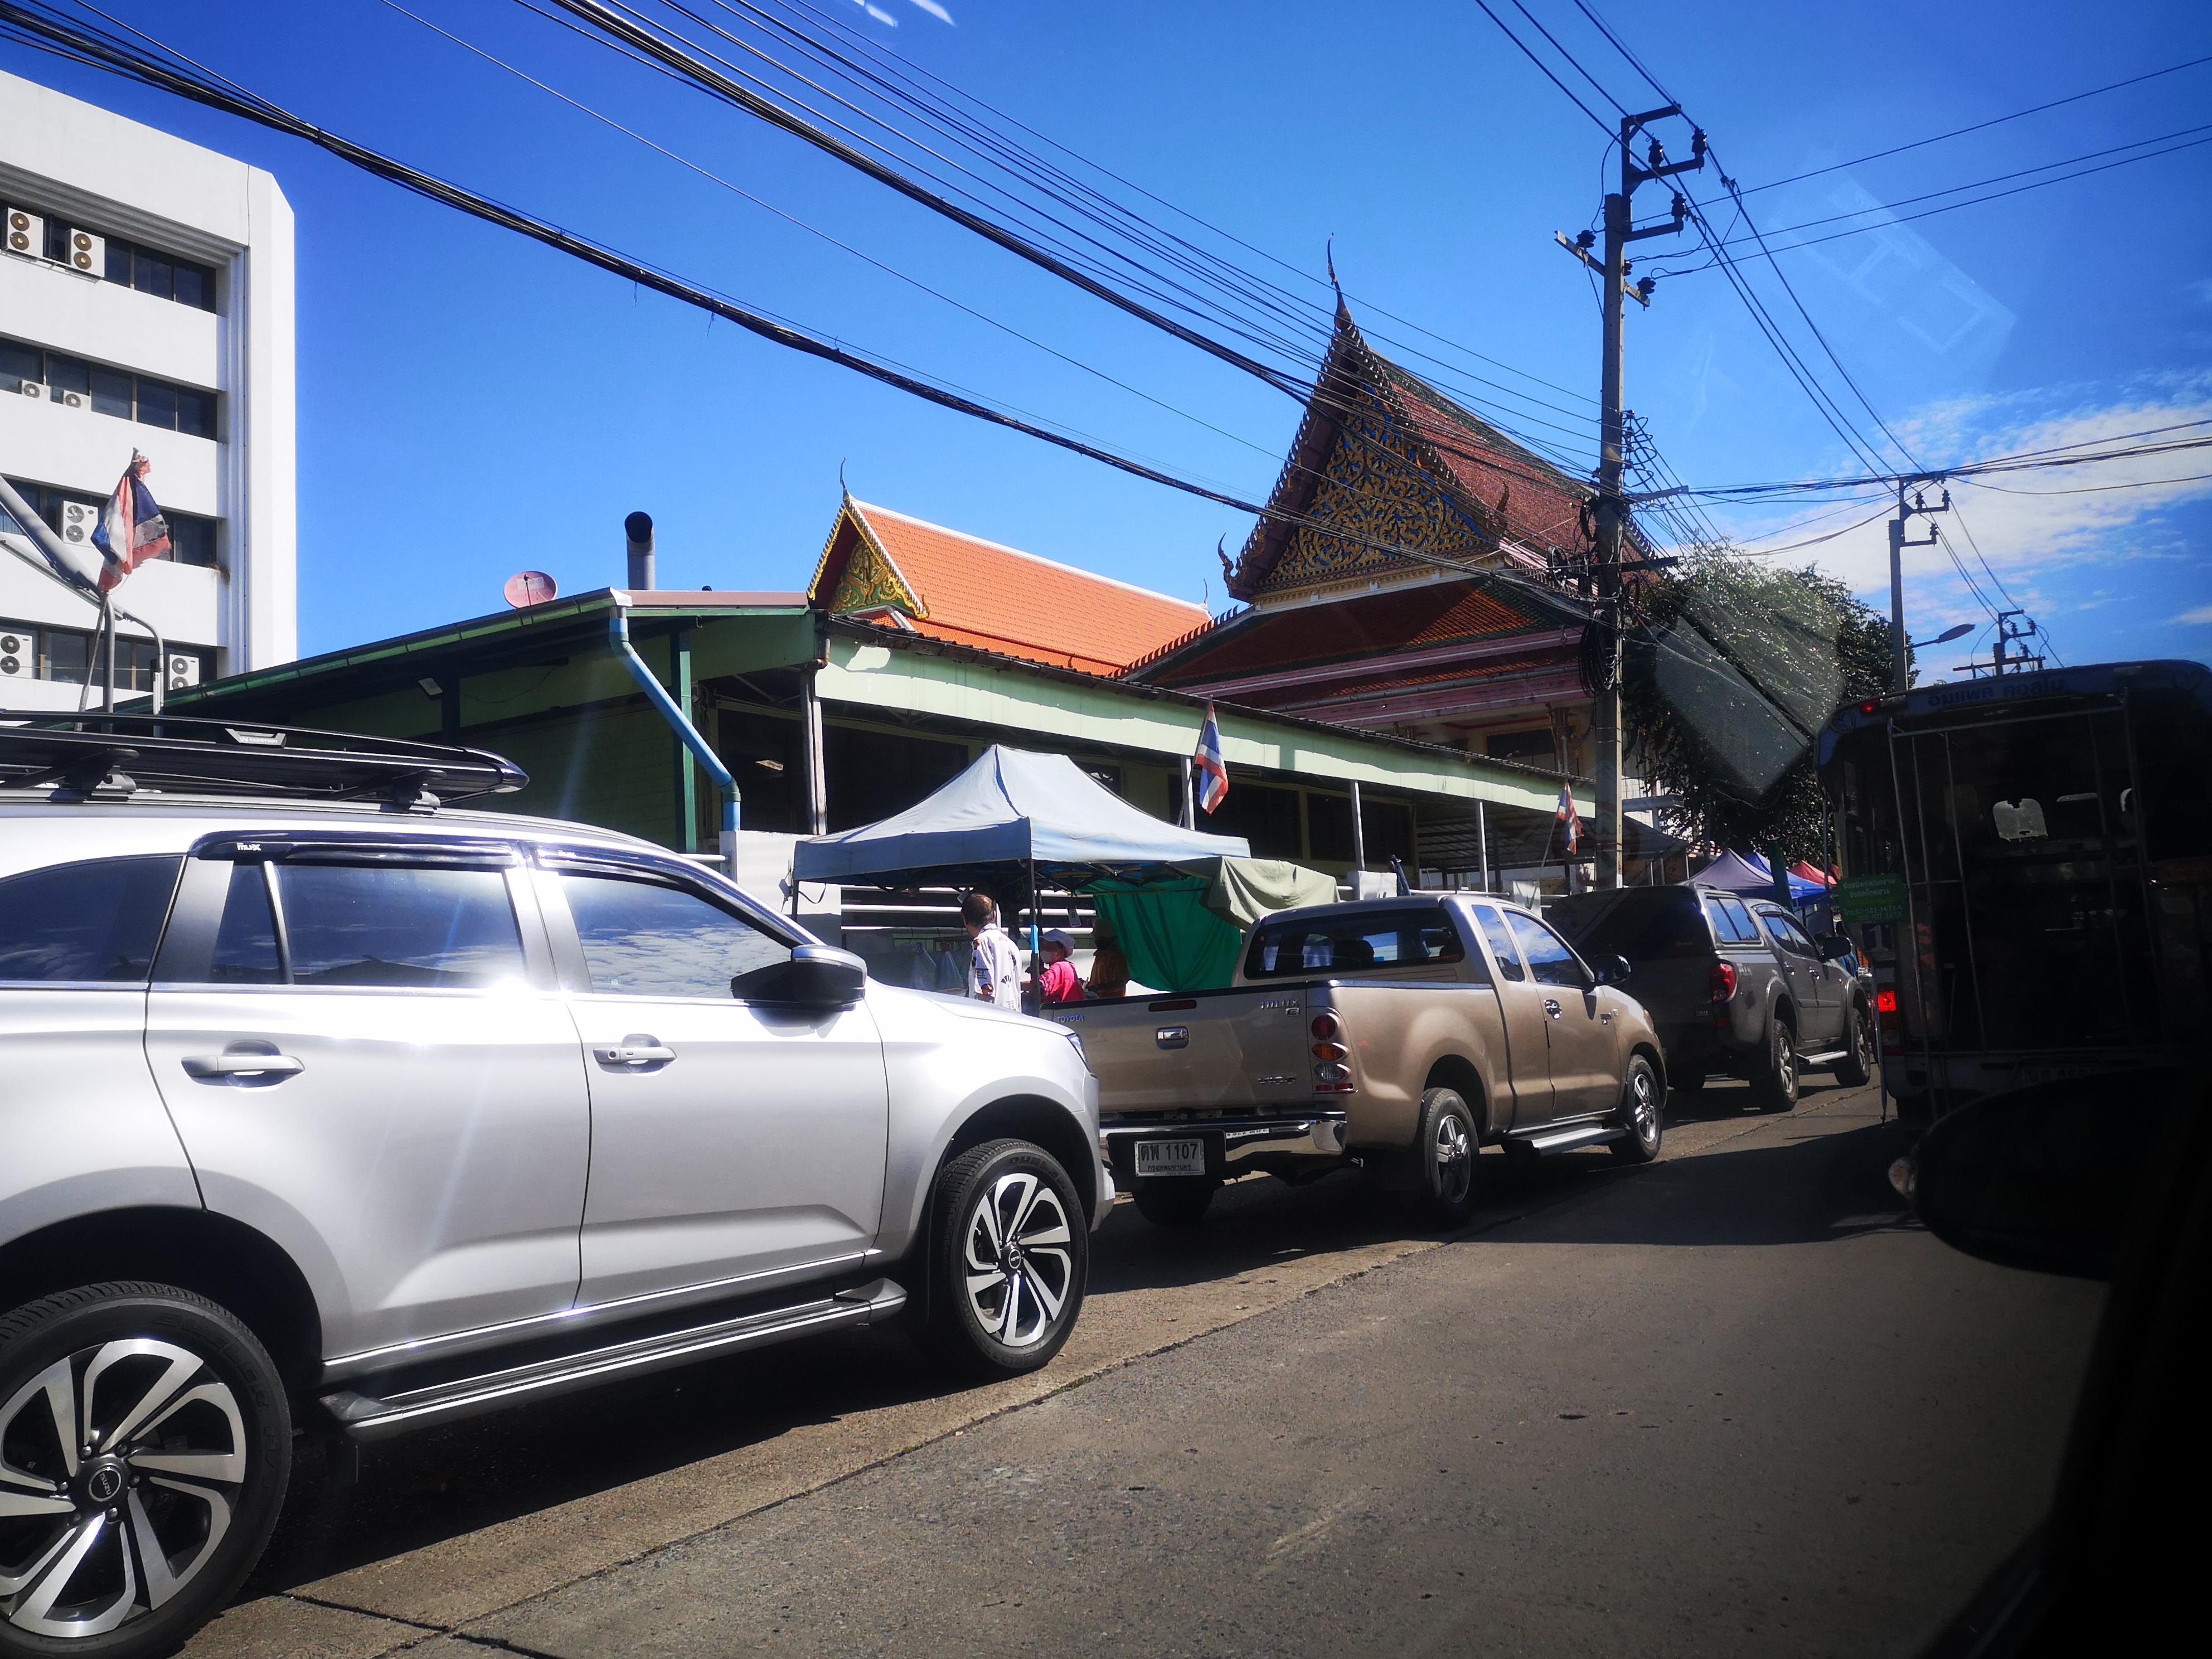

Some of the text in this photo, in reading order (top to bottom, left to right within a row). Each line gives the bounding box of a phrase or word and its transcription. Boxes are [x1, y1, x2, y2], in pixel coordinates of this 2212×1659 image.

[1057, 1015, 1085, 1023] TOYOTA
[1166, 1143, 1197, 1160] 1107
[99, 1472, 111, 1495] ISUZU
